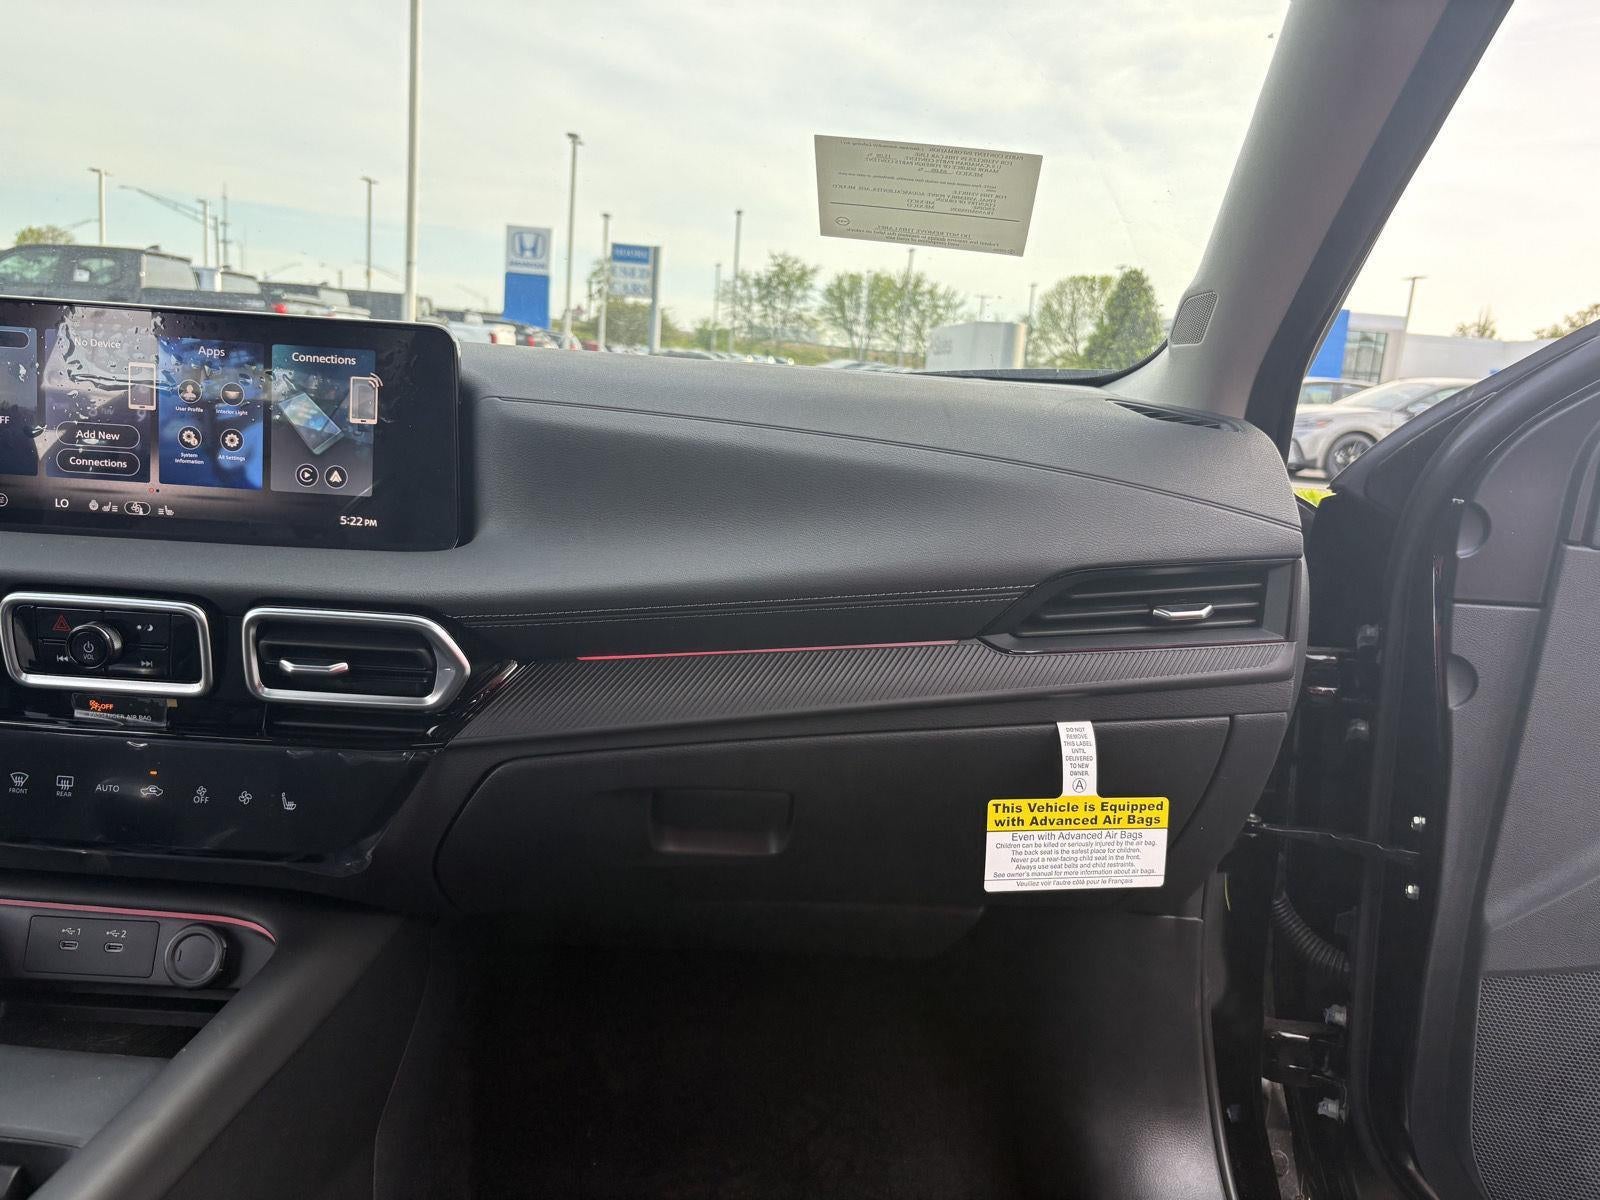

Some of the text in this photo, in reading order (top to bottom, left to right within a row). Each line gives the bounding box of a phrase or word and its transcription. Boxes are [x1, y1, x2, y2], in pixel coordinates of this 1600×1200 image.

[75, 338, 121, 348] No Device
[198, 345, 226, 358] Apps
[292, 352, 357, 365] Connections
[75, 430, 120, 441] Add New
[69, 456, 127, 468] Connections
[55, 499, 69, 508] LO
[340, 516, 377, 527] 5:22 PM
[56, 790, 72, 798] REAR
[96, 784, 120, 793] AUTO
[193, 796, 209, 804] OFF
[993, 801, 1163, 813] This Vehicle is Equipped
[995, 815, 1160, 826] with Advanced Air Bags
[1012, 833, 1034, 841] Even
[1058, 831, 1102, 840] Advanced
[1105, 831, 1117, 839] Air
[1120, 831, 1143, 840] Bags
